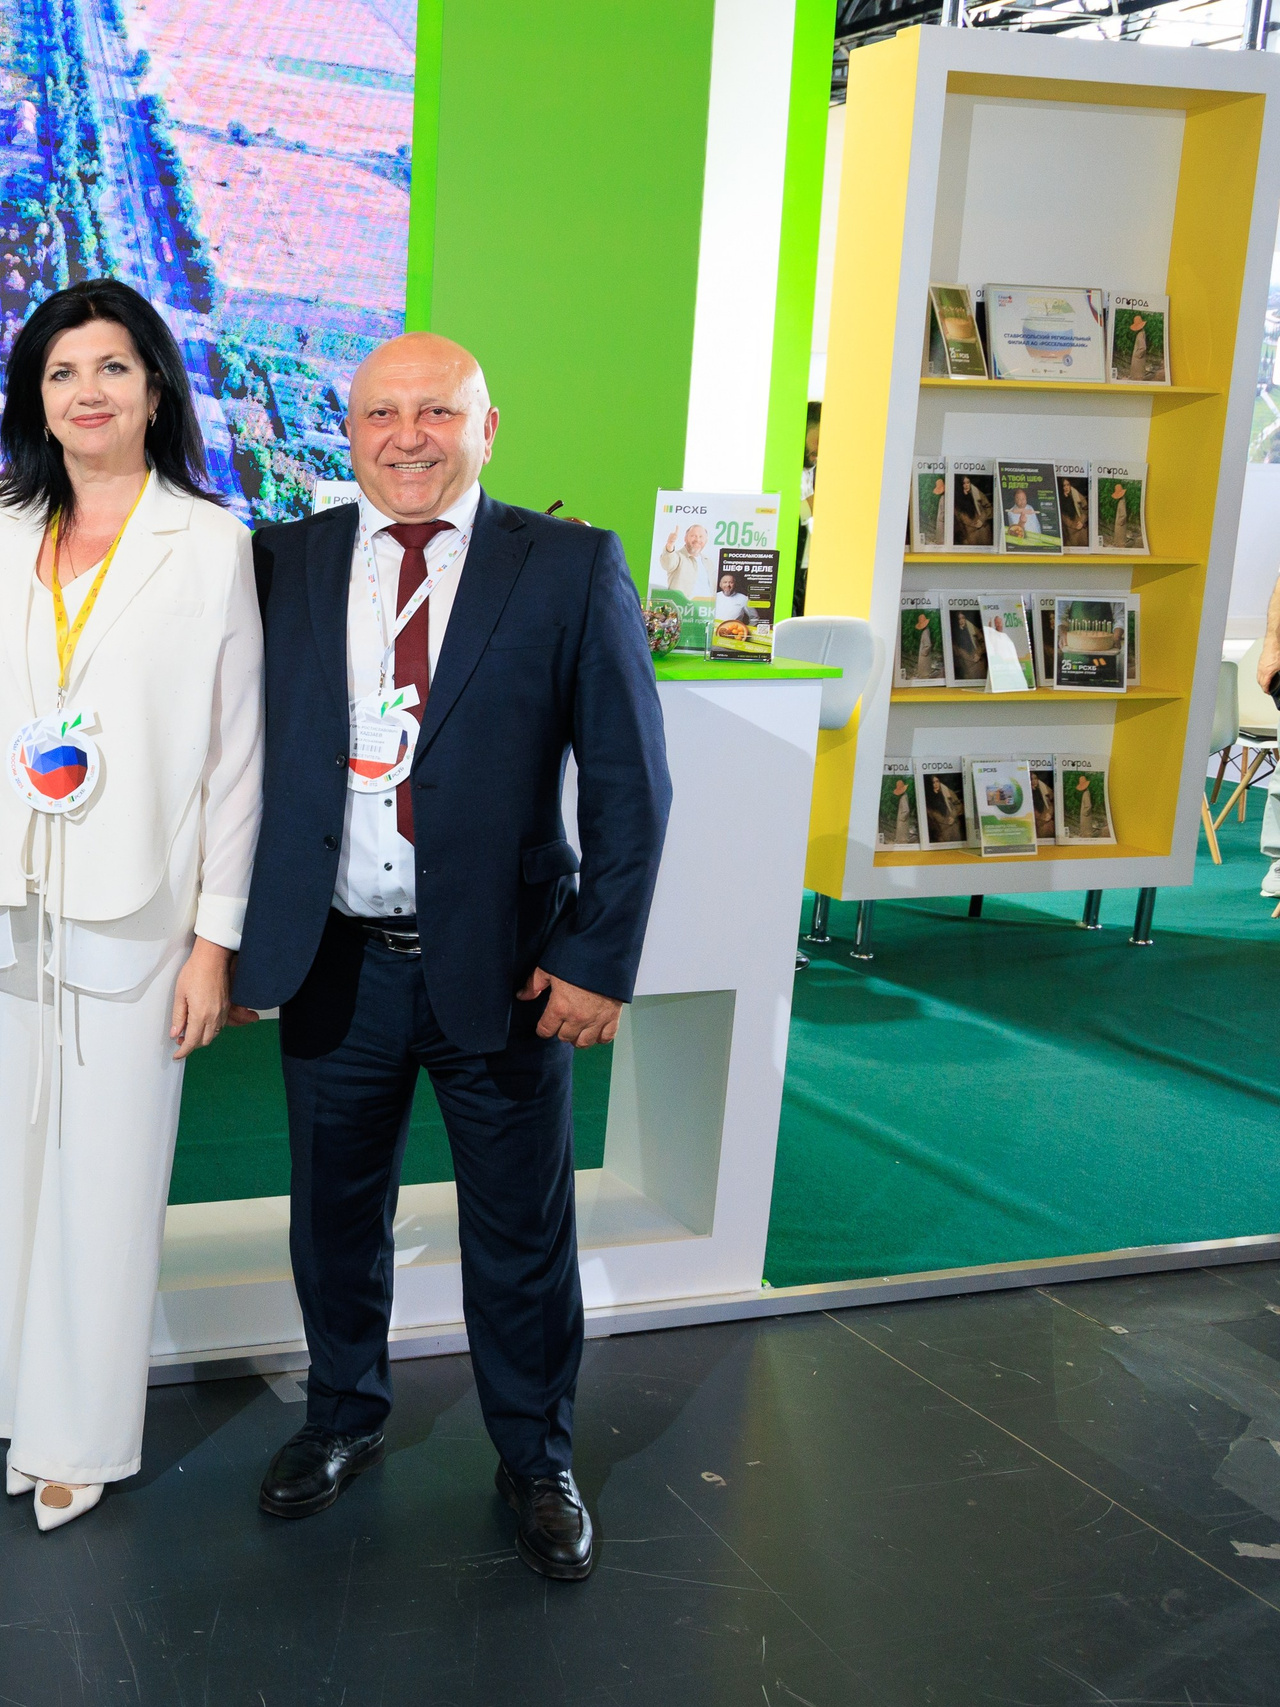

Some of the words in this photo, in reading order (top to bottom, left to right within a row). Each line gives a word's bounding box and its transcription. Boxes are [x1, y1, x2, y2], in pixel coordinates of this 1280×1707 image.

[1003, 332, 1050, 340] СТАВРОПОЛЬСКИЙ
[917, 462, 946, 472] огоро
[1008, 474, 1026, 482] ТВОЙ
[333, 496, 357, 505] РСХ
[675, 505, 708, 515] РСХБ
[722, 564, 743, 572] ШЕФ
[751, 565, 774, 573] ДЕЛЕ
[884, 763, 910, 773] город
